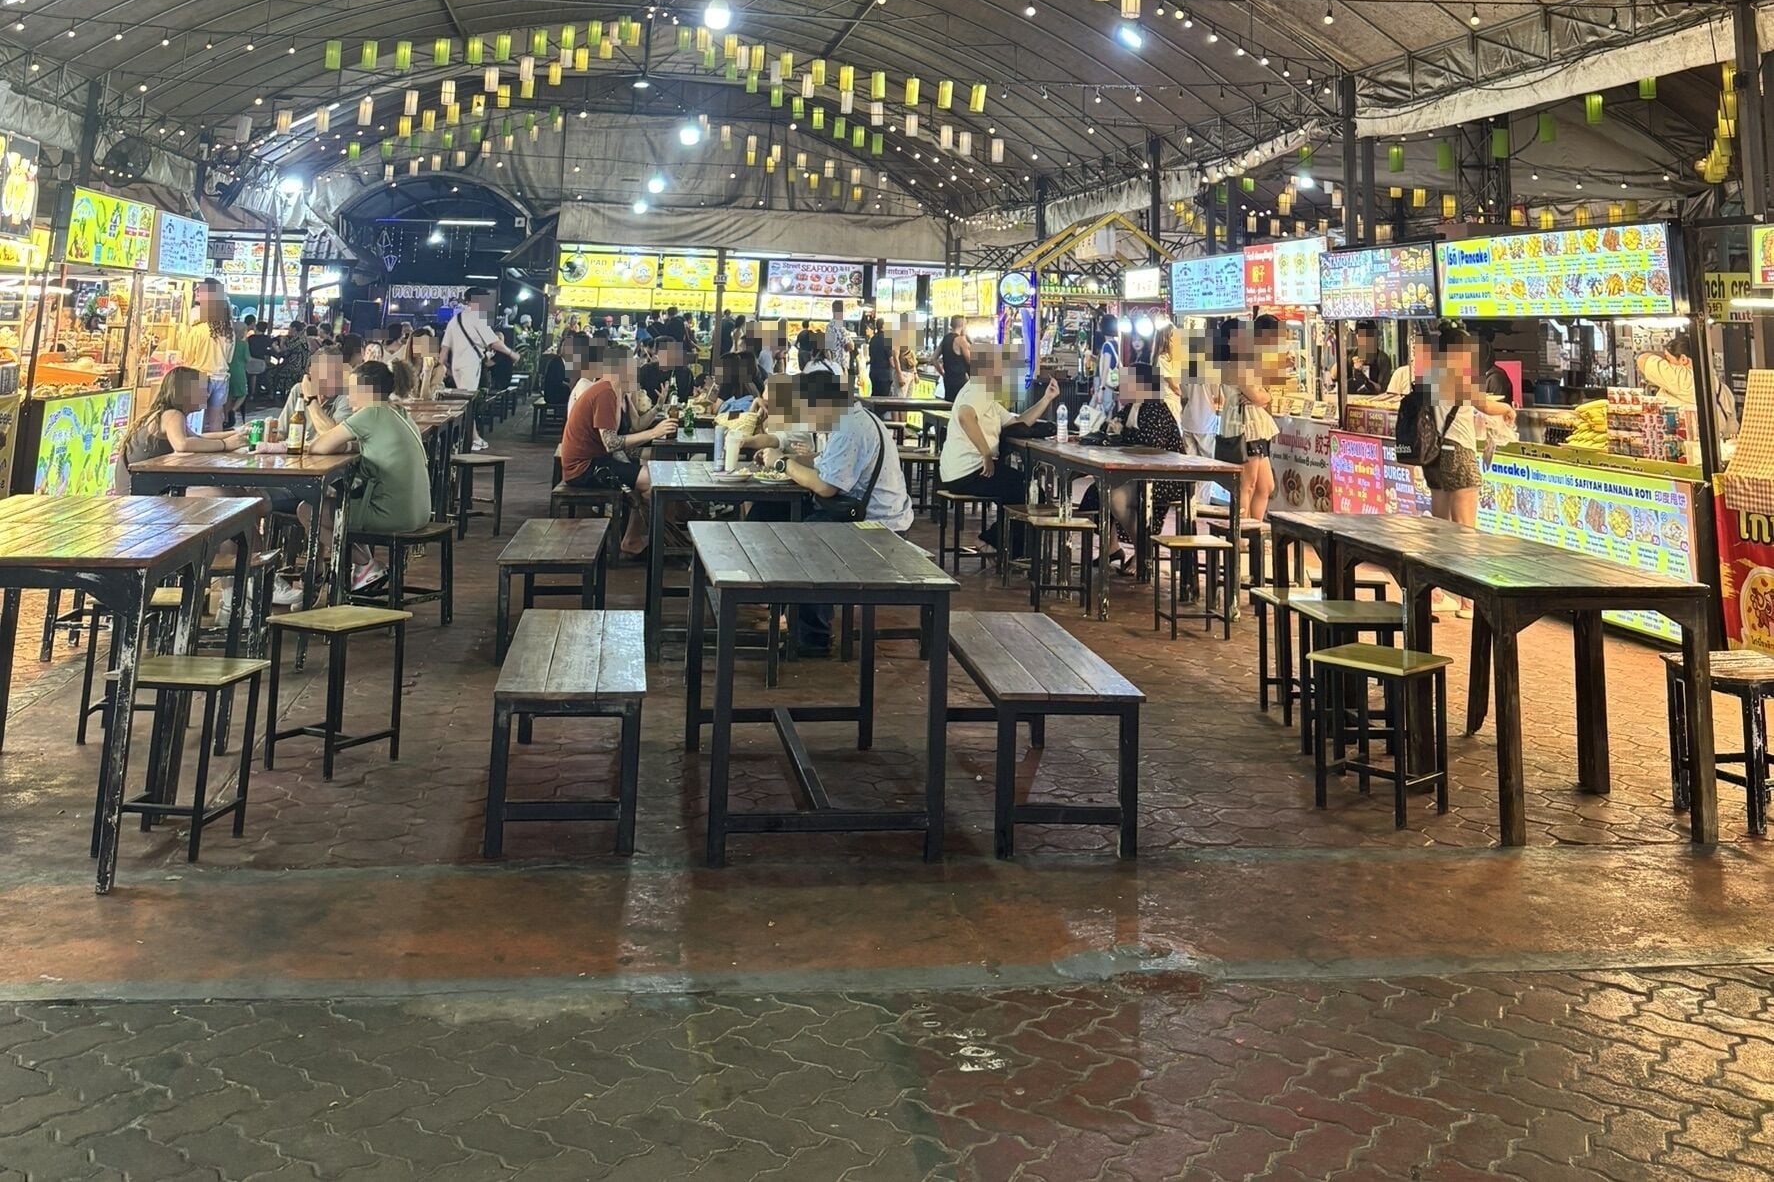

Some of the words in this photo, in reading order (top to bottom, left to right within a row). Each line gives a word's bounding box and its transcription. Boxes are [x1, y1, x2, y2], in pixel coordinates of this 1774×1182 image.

[1459, 247, 1491, 267] (Pancake)
[801, 264, 839, 273] SEAFOOD
[1384, 465, 1411, 483] BURGER
[1575, 478, 1603, 492] SAFIYAH
[1604, 483, 1634, 497] BANANA
[1635, 488, 1652, 500] ROTI
